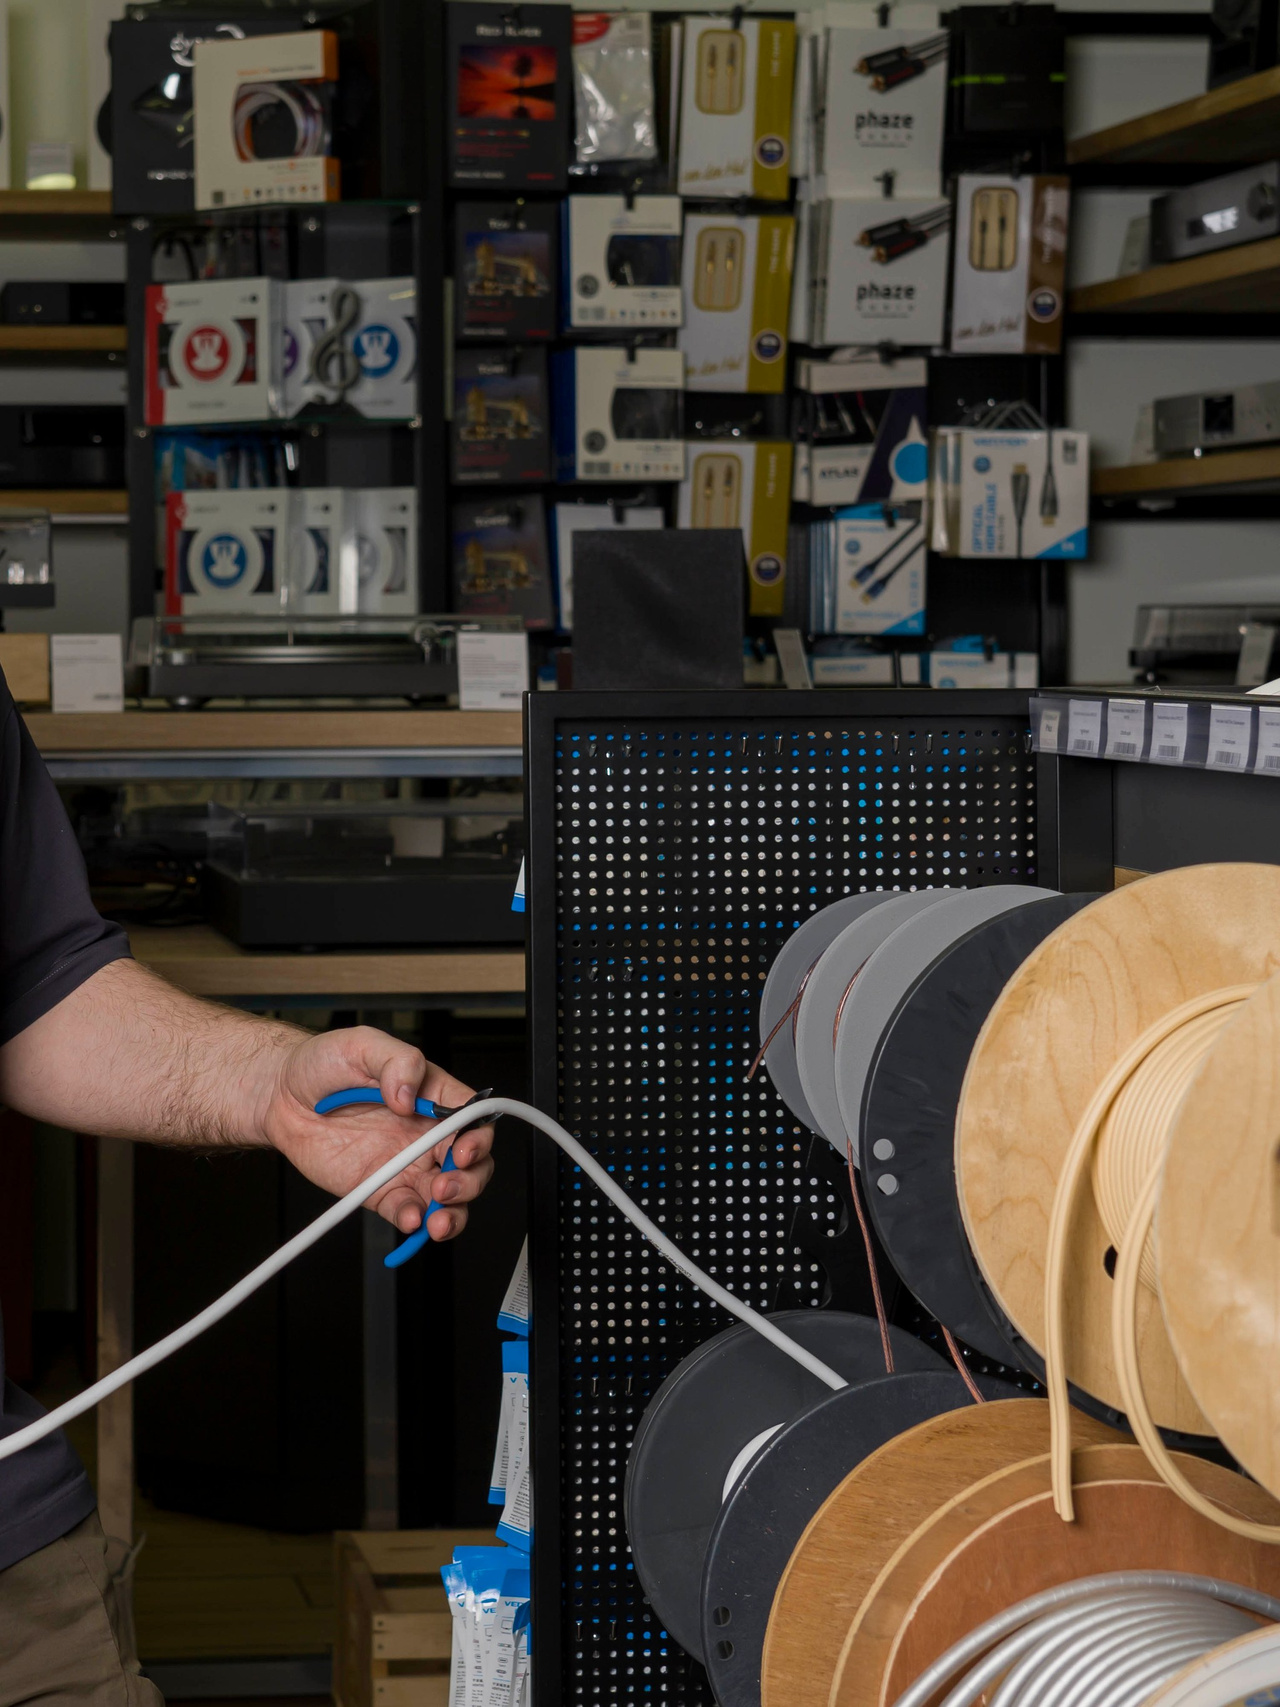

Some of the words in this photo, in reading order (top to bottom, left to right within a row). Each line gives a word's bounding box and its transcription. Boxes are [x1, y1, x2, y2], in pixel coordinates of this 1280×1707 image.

[855, 109, 913, 131] phaze
[857, 281, 915, 303] phaze
[819, 466, 859, 480] ATLAS
